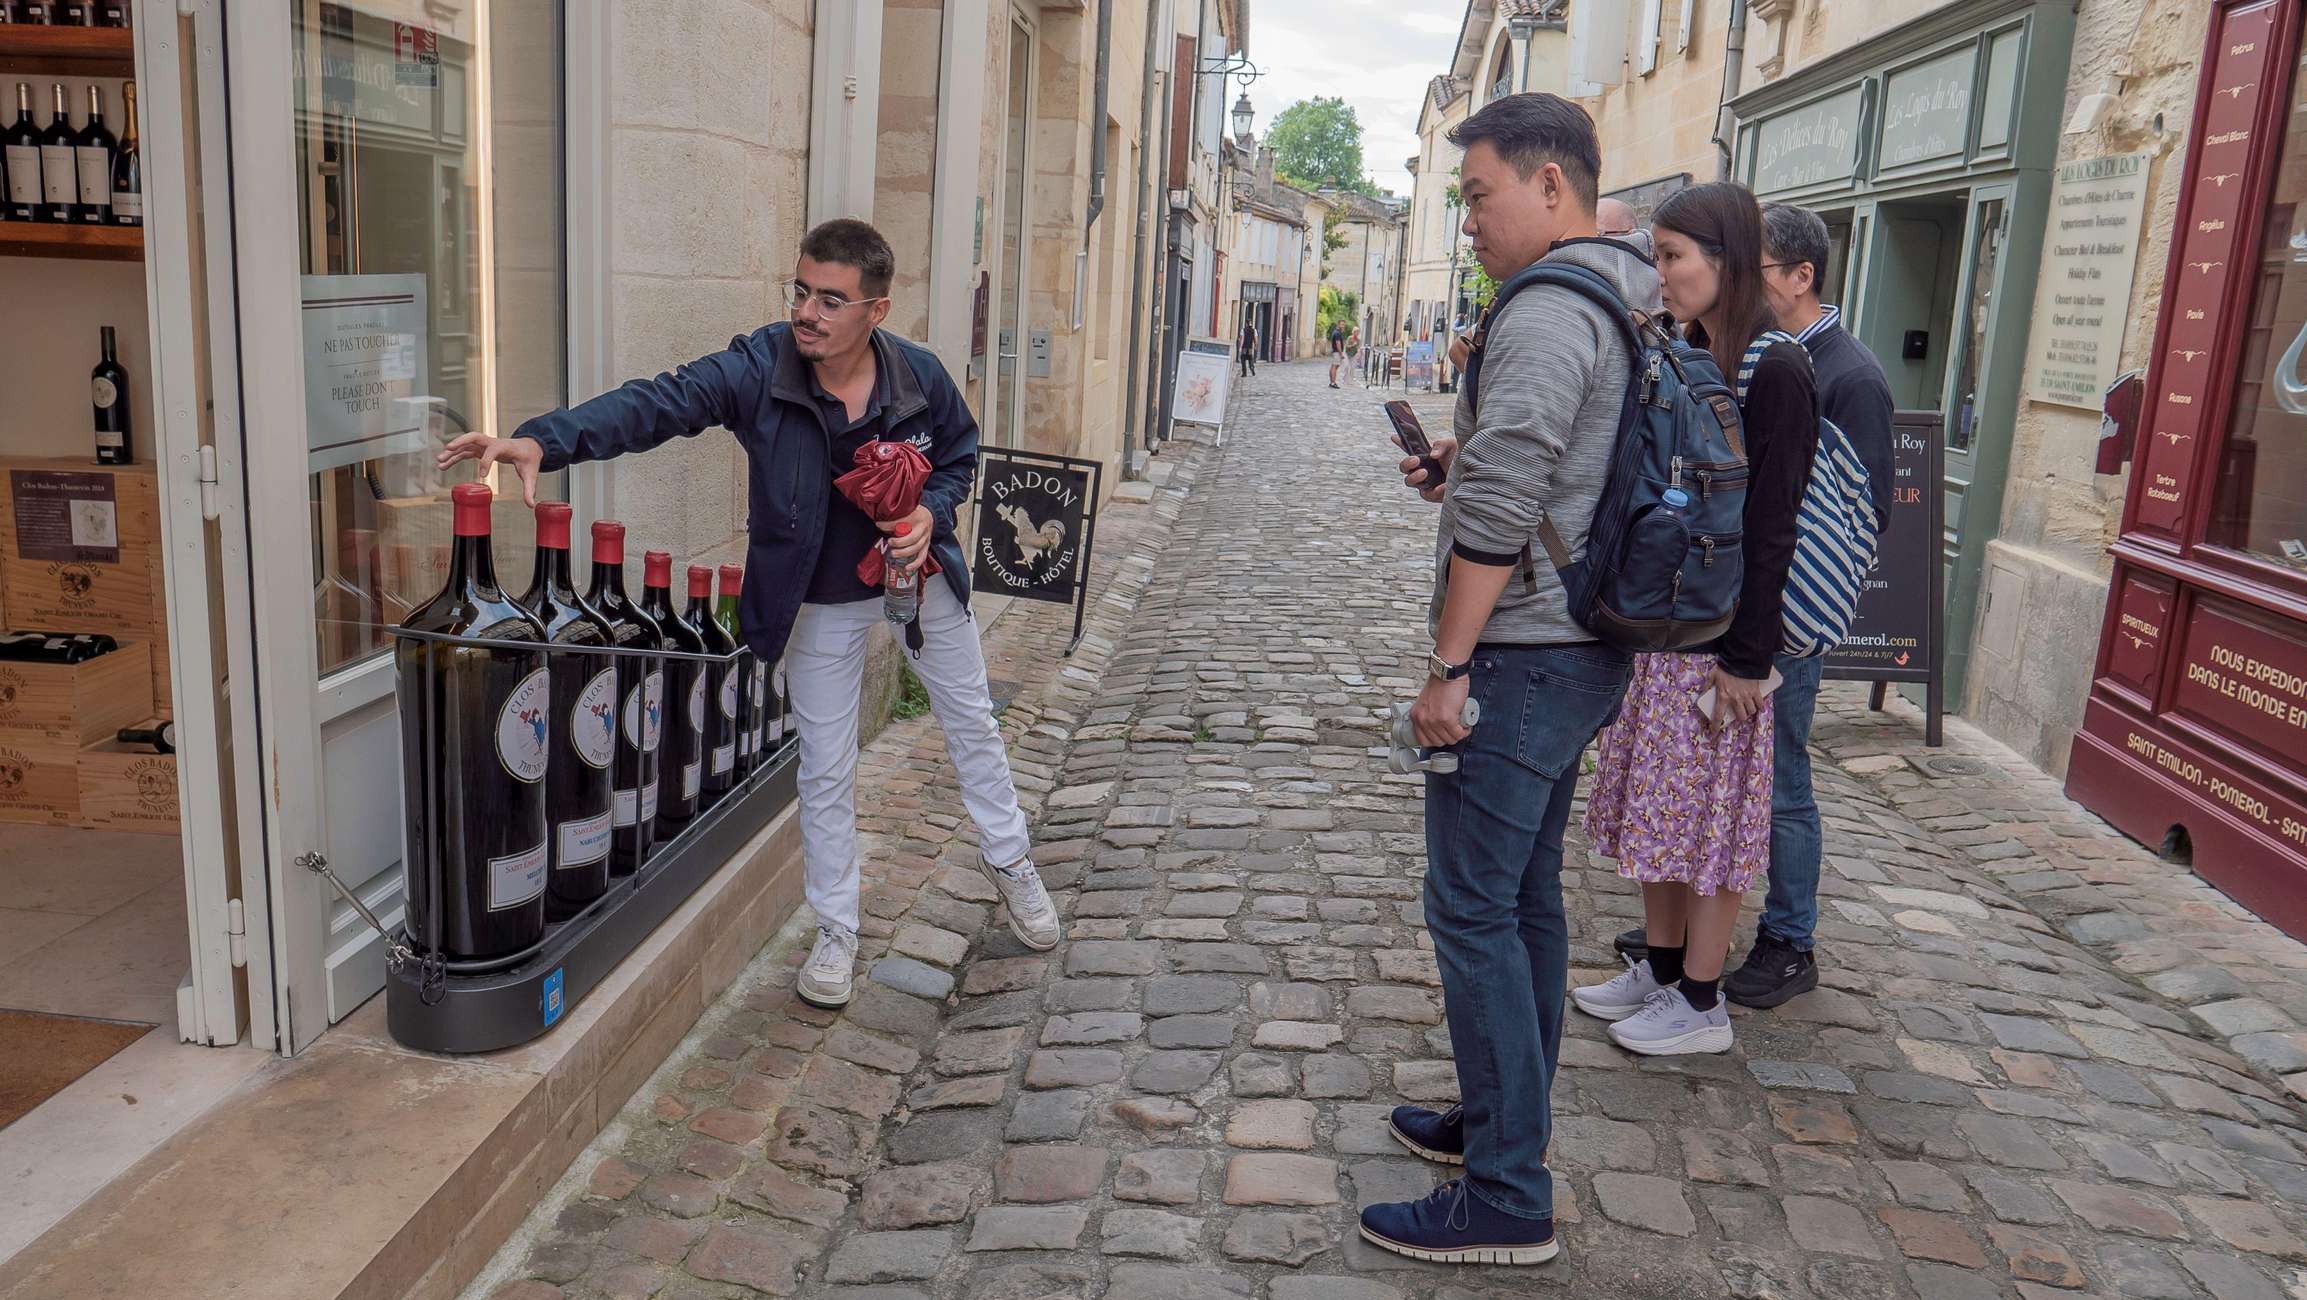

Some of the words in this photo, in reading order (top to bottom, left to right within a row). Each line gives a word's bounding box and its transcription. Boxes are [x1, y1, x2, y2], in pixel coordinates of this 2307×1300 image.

[2231, 43, 2255, 56] Petrus
[1931, 78, 1944, 110] du
[1812, 111, 1826, 146] du
[2206, 133, 2228, 146] Cheval
[2230, 131, 2249, 141] Blanc
[2186, 309, 2205, 320] Pavie
[324, 338, 337, 353] NE
[340, 337, 353, 351] PAS
[332, 385, 364, 401] PLEASE
[2168, 392, 2192, 405] Ausone
[345, 398, 381, 415] TOUCH
[1901, 433, 1926, 455] Roy
[991, 471, 1078, 508] BADON
[2156, 474, 2176, 486] Tertre
[982, 537, 1030, 588] BOUTIQUE
[1040, 548, 1074, 585] HÔTEL
[2121, 613, 2159, 638] SPIRITUEUX
[2210, 645, 2245, 673] NOUS
[510, 684, 535, 714] CLOS
[583, 681, 603, 708] CLOS
[2187, 662, 2219, 690] DANS
[2220, 677, 2236, 698] LE
[2237, 684, 2288, 720] MONDE
[2128, 732, 2156, 758] SAINT
[2157, 749, 2202, 786] EMILION
[2210, 777, 2271, 825] POMEROL
